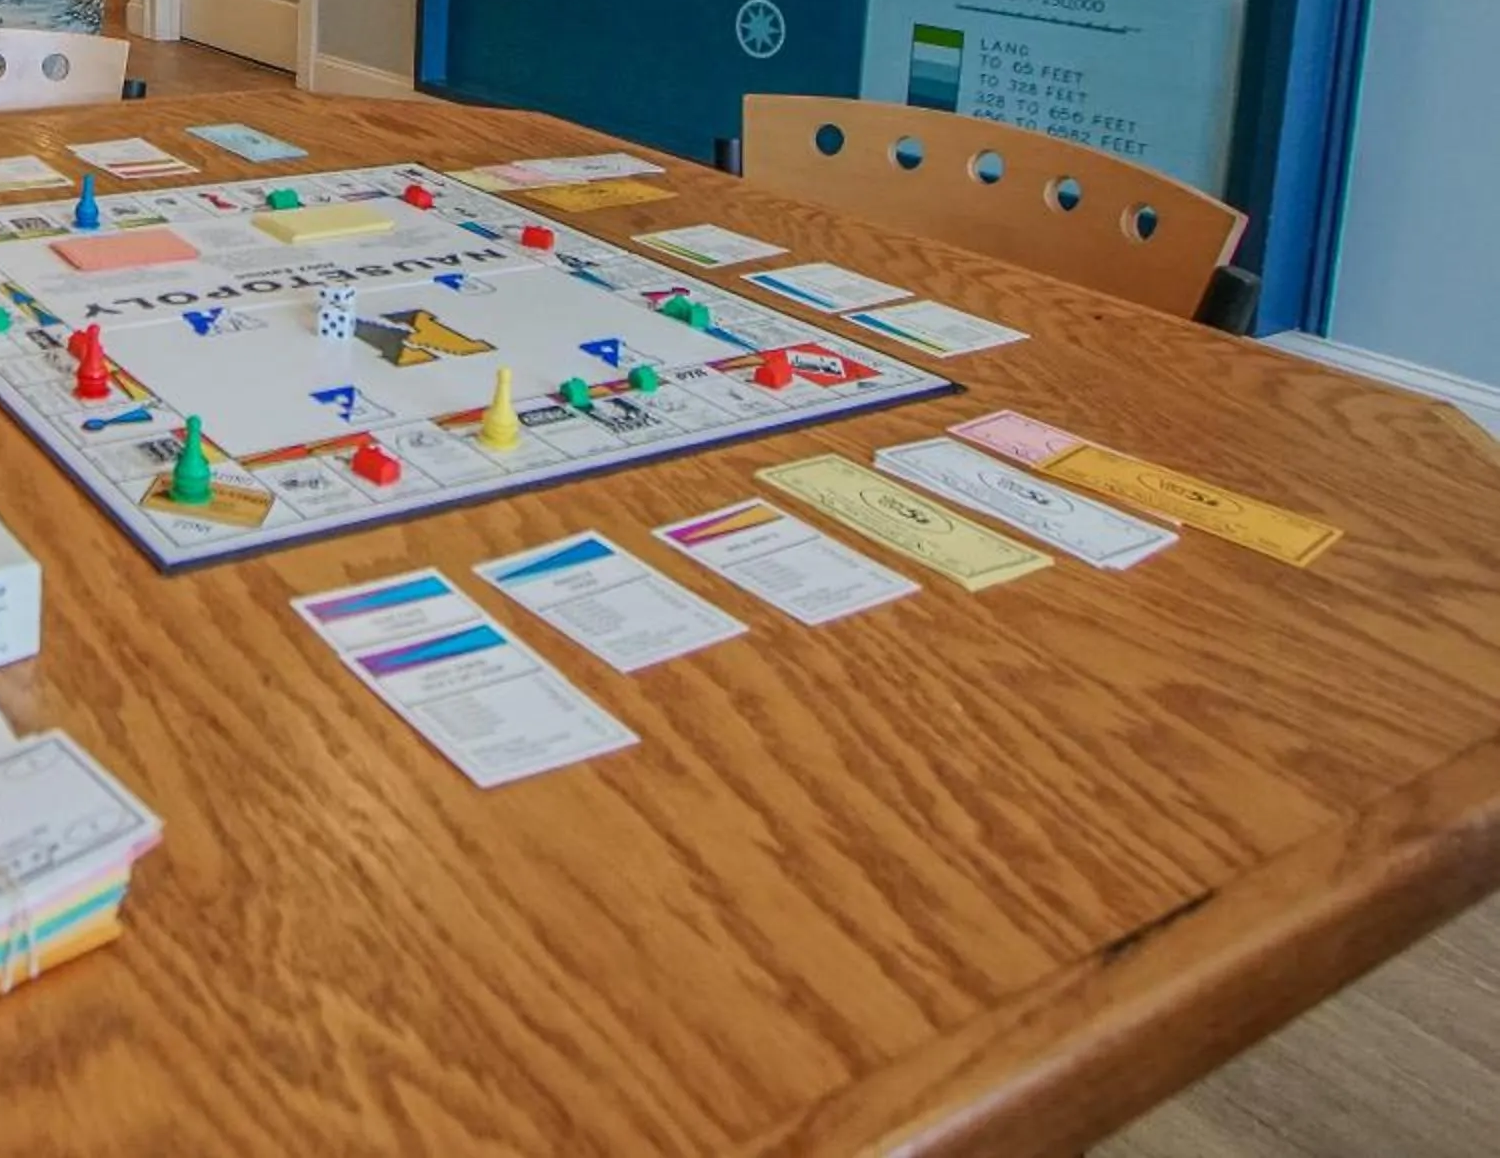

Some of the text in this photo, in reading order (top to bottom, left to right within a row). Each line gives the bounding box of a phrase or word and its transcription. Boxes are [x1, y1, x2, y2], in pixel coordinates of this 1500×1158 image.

[980, 53, 1001, 69] TO
[1041, 66, 1084, 84] FEET
[980, 73, 1088, 104] TO 328 FEET
[975, 92, 1005, 109] 328
[1016, 99, 1039, 115] TO
[1091, 115, 1137, 134] FEET
[1015, 117, 1038, 131] TO
[1101, 135, 1148, 155] FEET
[85, 248, 508, 318] NAUSETOPOLY
